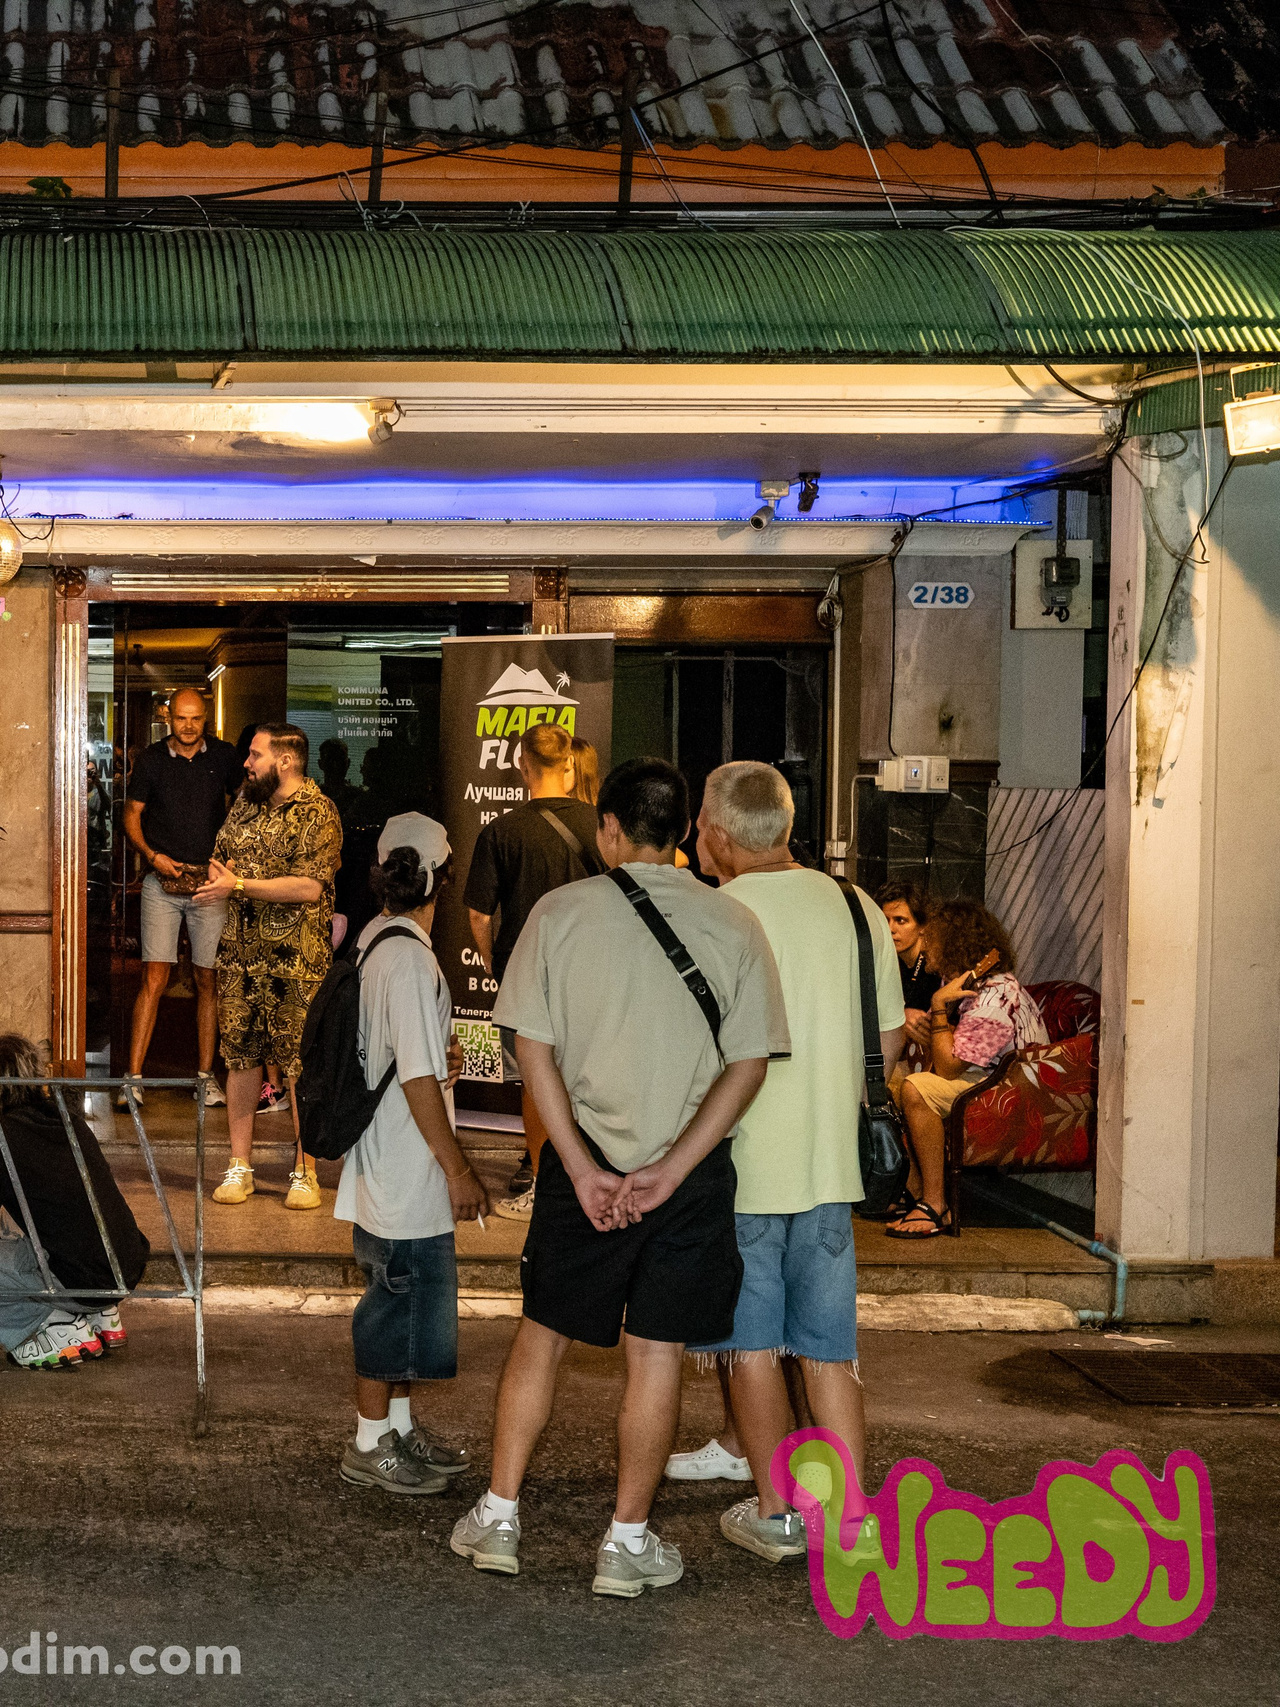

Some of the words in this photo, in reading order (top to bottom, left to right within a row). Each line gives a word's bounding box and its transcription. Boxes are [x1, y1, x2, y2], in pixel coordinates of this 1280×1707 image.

[913, 585, 969, 604] 2/38
[337, 686, 389, 695] KOMMUNA
[337, 698, 373, 706] UNITED
[396, 698, 415, 707] LTD.
[476, 706, 577, 738] MAFIA
[464, 783, 524, 804] Лучшая
[481, 978, 499, 993] со
[454, 1006, 493, 1018] Телегра
